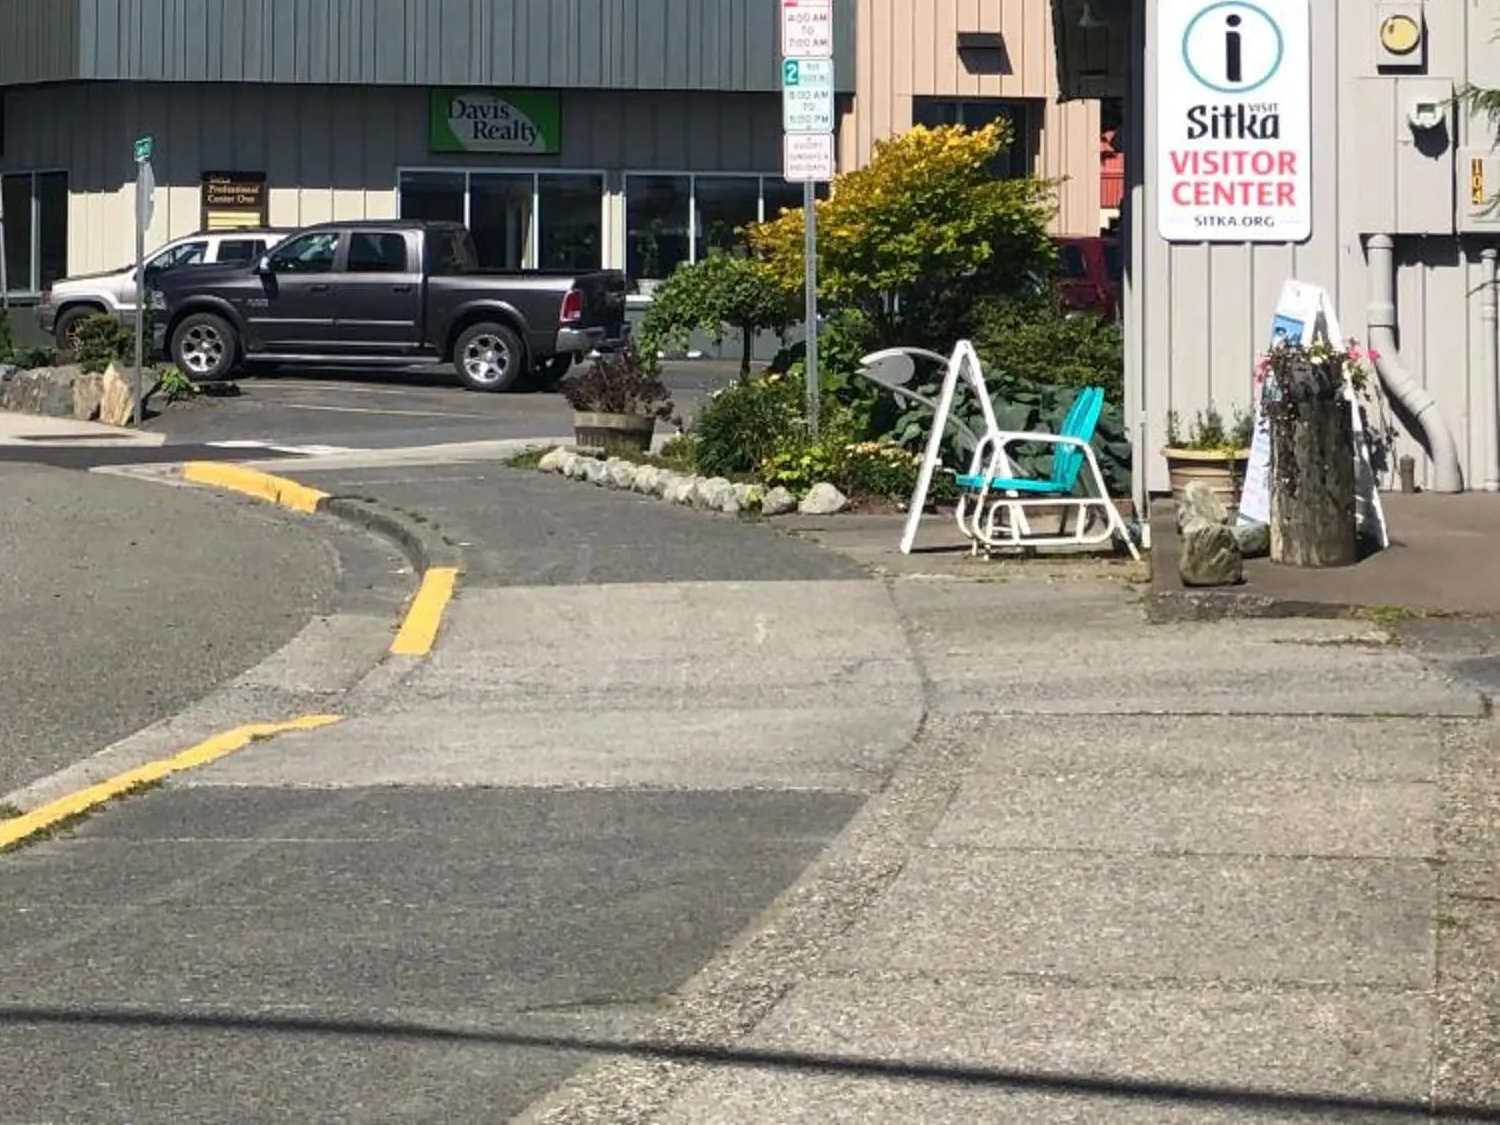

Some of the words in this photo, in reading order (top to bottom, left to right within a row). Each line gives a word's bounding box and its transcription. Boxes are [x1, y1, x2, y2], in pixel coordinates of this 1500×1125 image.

[812, 13, 828, 22] AM
[812, 39, 828, 48] AM
[786, 63, 798, 83] 2
[813, 91, 829, 100] AM
[448, 99, 511, 120] Davis
[1248, 103, 1280, 113] VISIT
[813, 115, 829, 124] PM
[1186, 103, 1280, 140] Sitka
[473, 119, 540, 147] Realty
[1169, 150, 1297, 176] VISITOR
[1171, 180, 1297, 207] CENTER
[1194, 215, 1275, 228] SITKA.ORG
